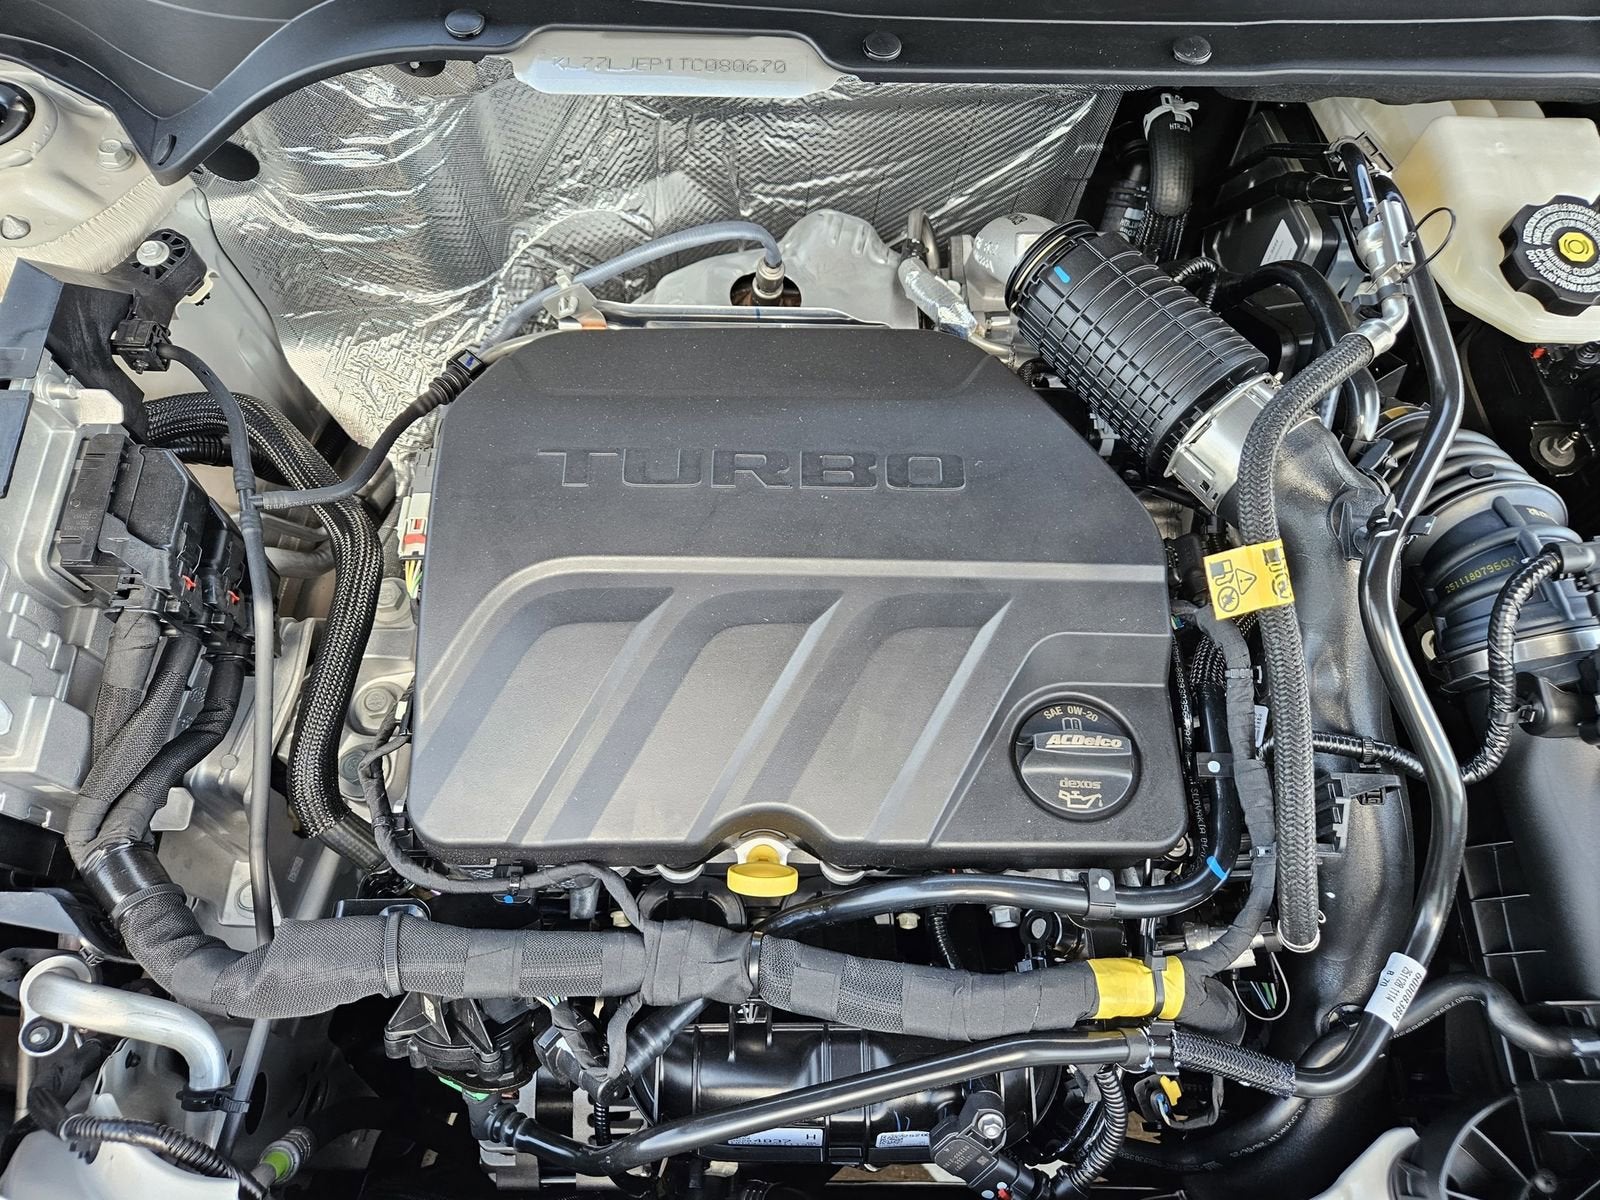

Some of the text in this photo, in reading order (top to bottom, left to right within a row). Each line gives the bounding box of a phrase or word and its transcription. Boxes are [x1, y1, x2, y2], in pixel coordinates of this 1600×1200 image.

[1536, 264, 1557, 282] FLUID
[1555, 277, 1577, 291] FROM
[537, 447, 966, 492] TURBO
[1043, 706, 1099, 722] SAE 0W-20
[1045, 733, 1124, 749] ACDelco
[1059, 777, 1102, 789] dexos
[1190, 787, 1207, 834] SLOVAKIA
